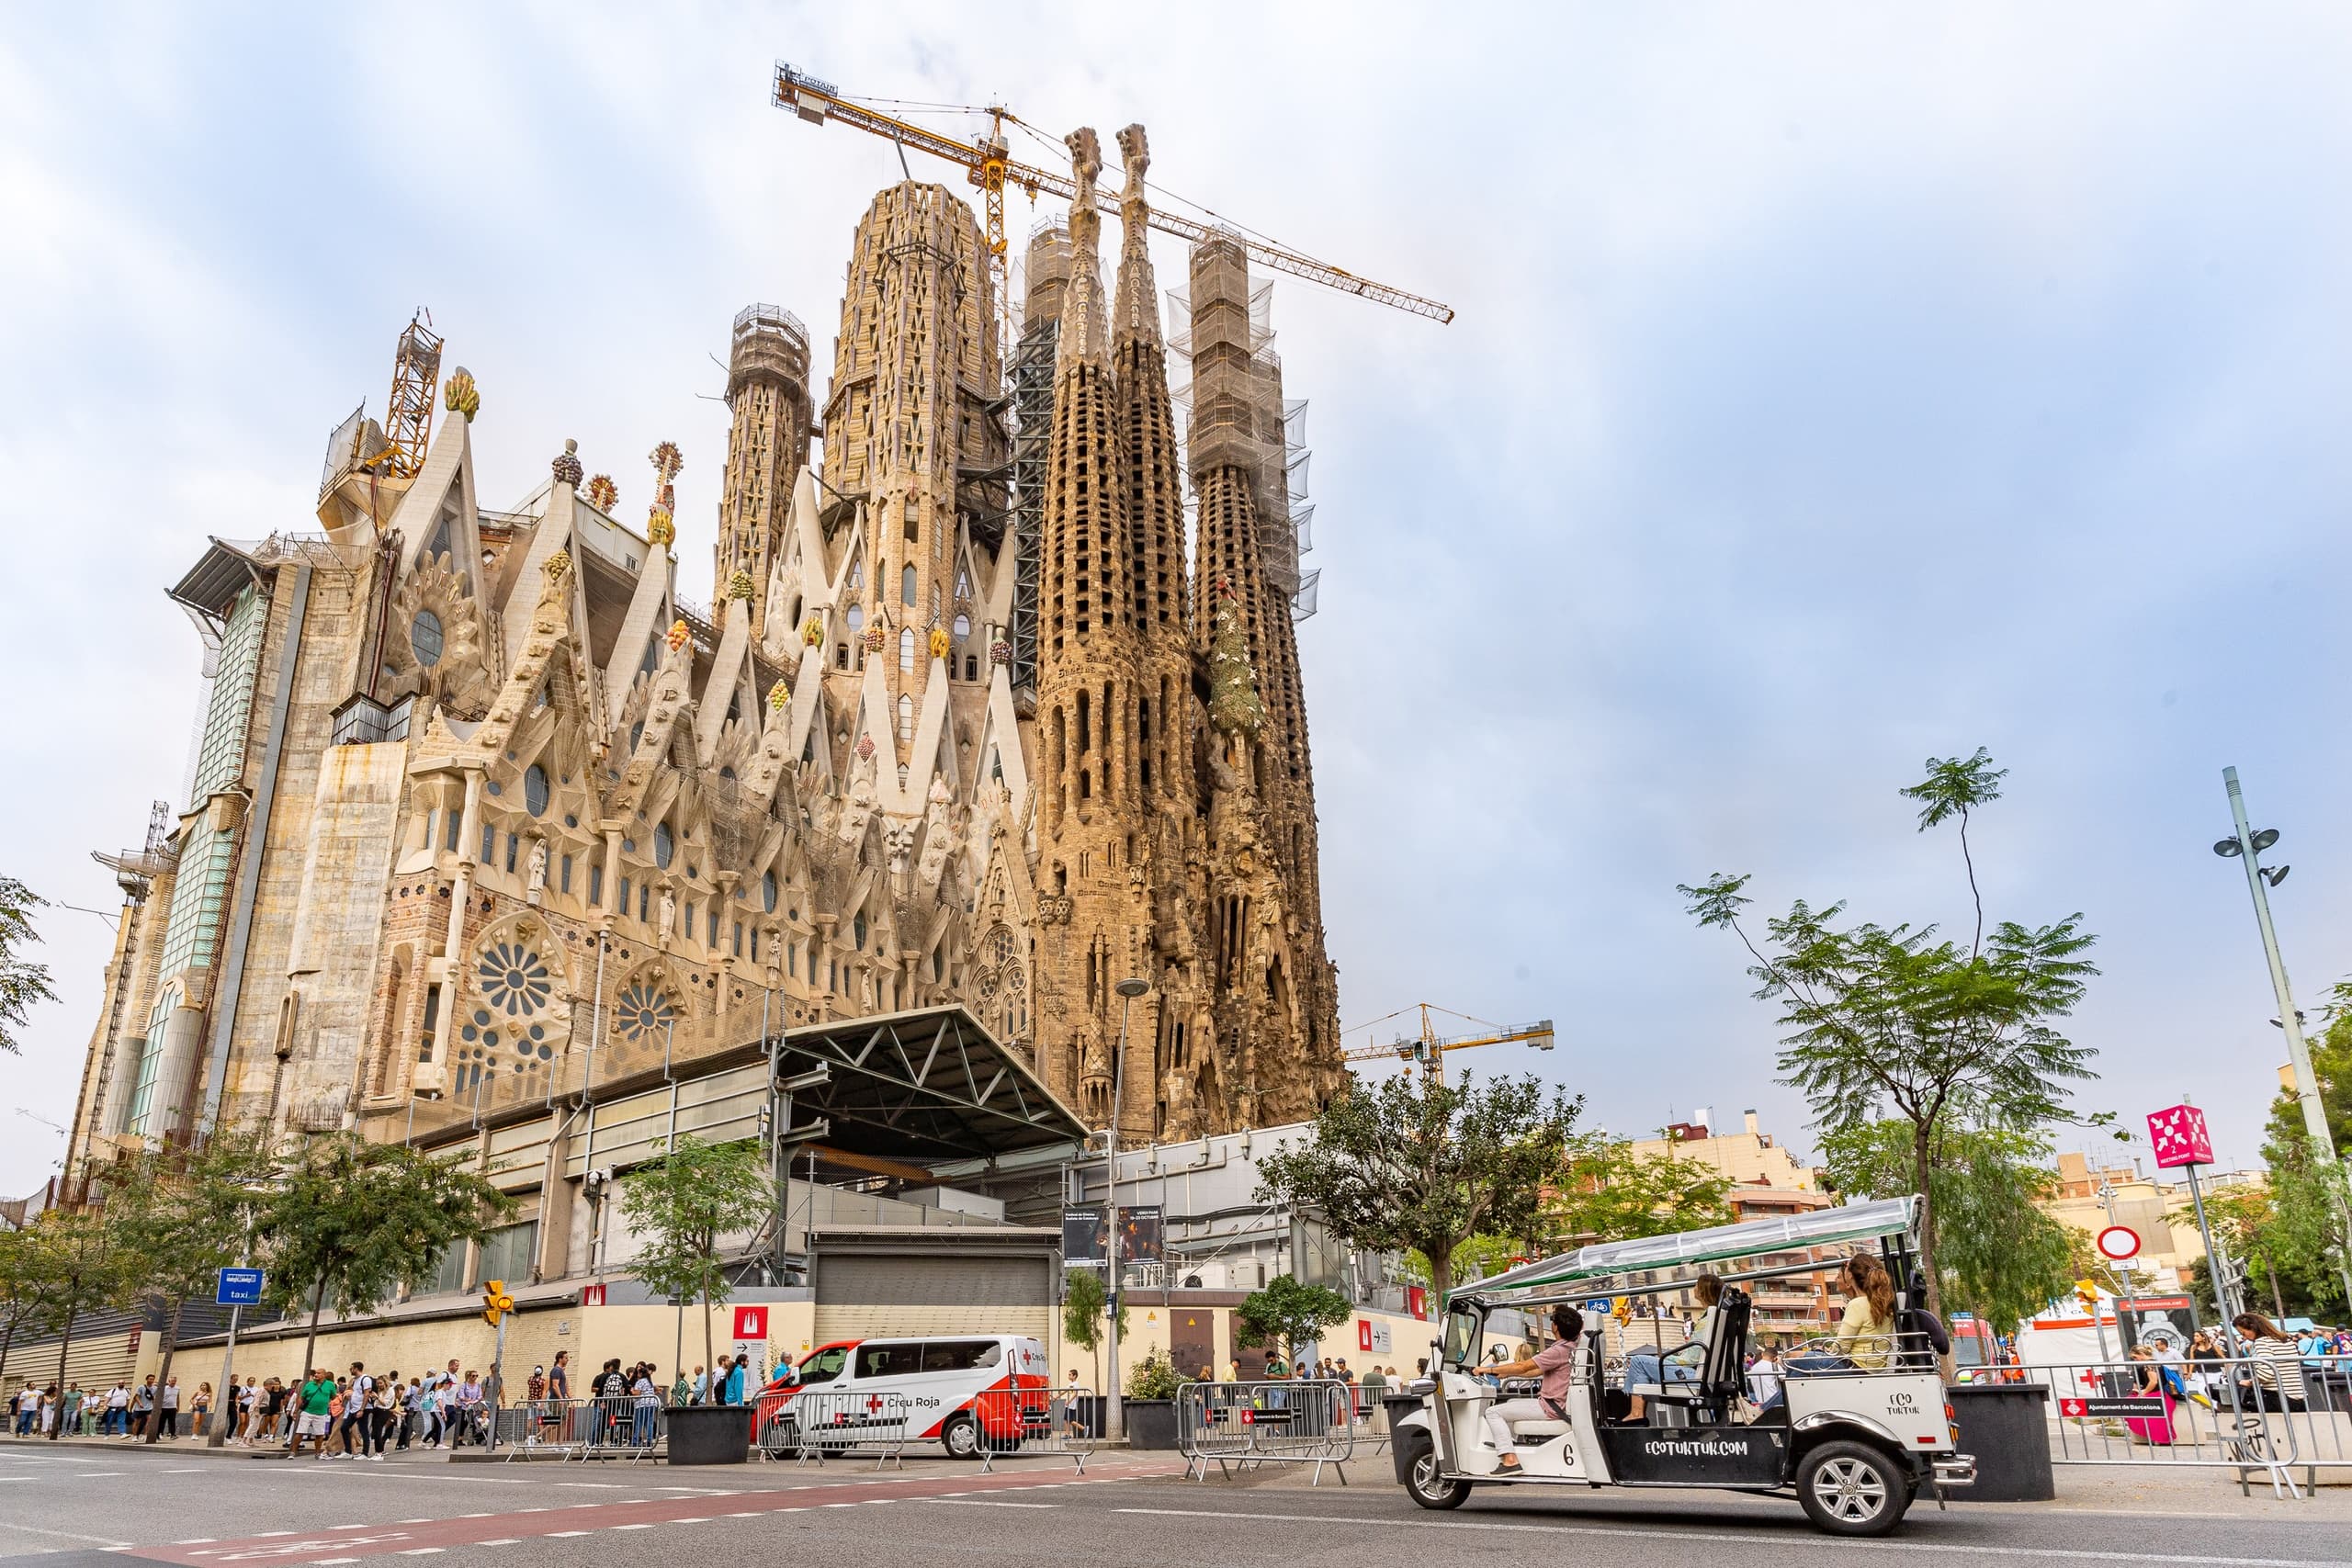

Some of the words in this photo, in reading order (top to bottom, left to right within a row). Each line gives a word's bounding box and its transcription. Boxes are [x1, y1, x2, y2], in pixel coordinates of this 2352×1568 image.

[2171, 1145, 2177, 1154] 2
[231, 1291, 248, 1299] taxi
[888, 1398, 912, 1407] Creu
[916, 1396, 940, 1409] Roja
[1890, 1393, 1912, 1406] ECO
[1886, 1406, 1920, 1416] TUKTUK
[1563, 1443, 1575, 1466] 6
[1645, 1441, 1747, 1456] ECOTUKTUK.COM
